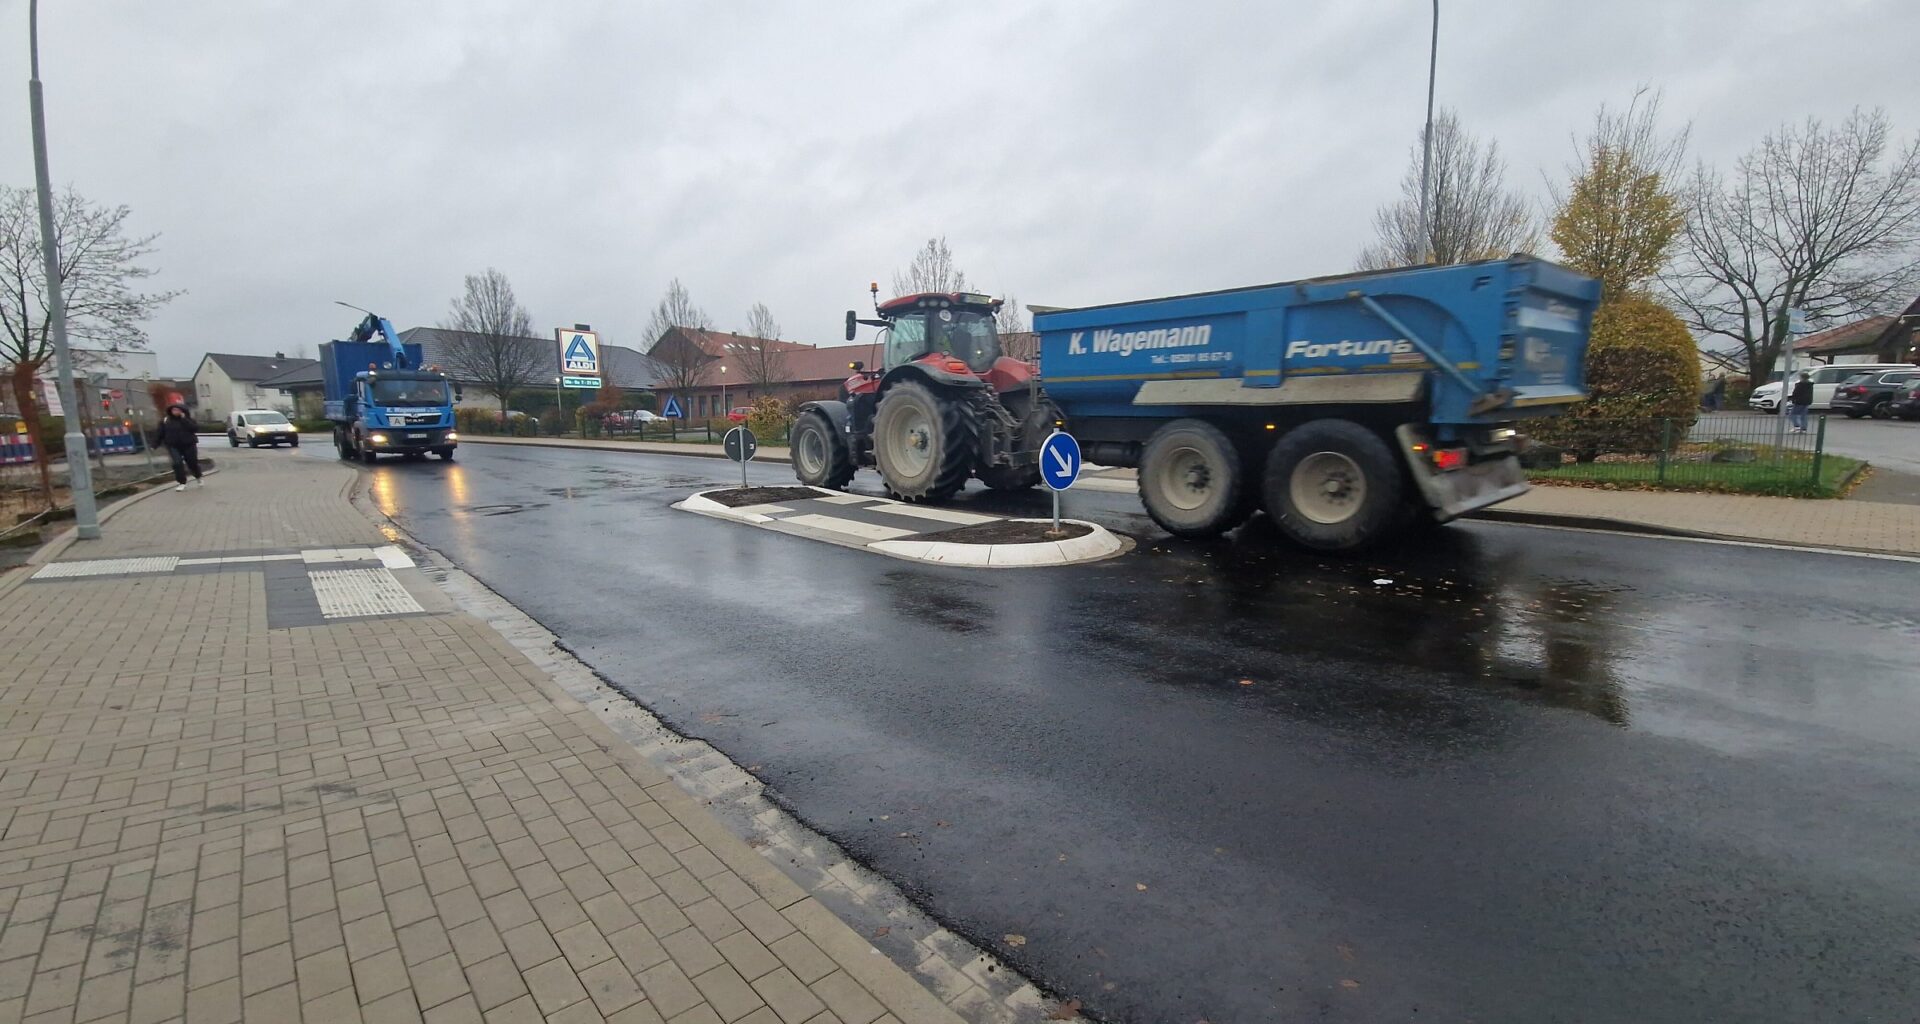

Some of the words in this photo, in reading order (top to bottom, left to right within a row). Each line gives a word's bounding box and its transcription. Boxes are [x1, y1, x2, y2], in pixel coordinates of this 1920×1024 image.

[1068, 332, 1087, 355] K.
[1092, 324, 1212, 357] Wagemann
[1285, 339, 1413, 359] Fortuna
[569, 361, 593, 369] ALDI
